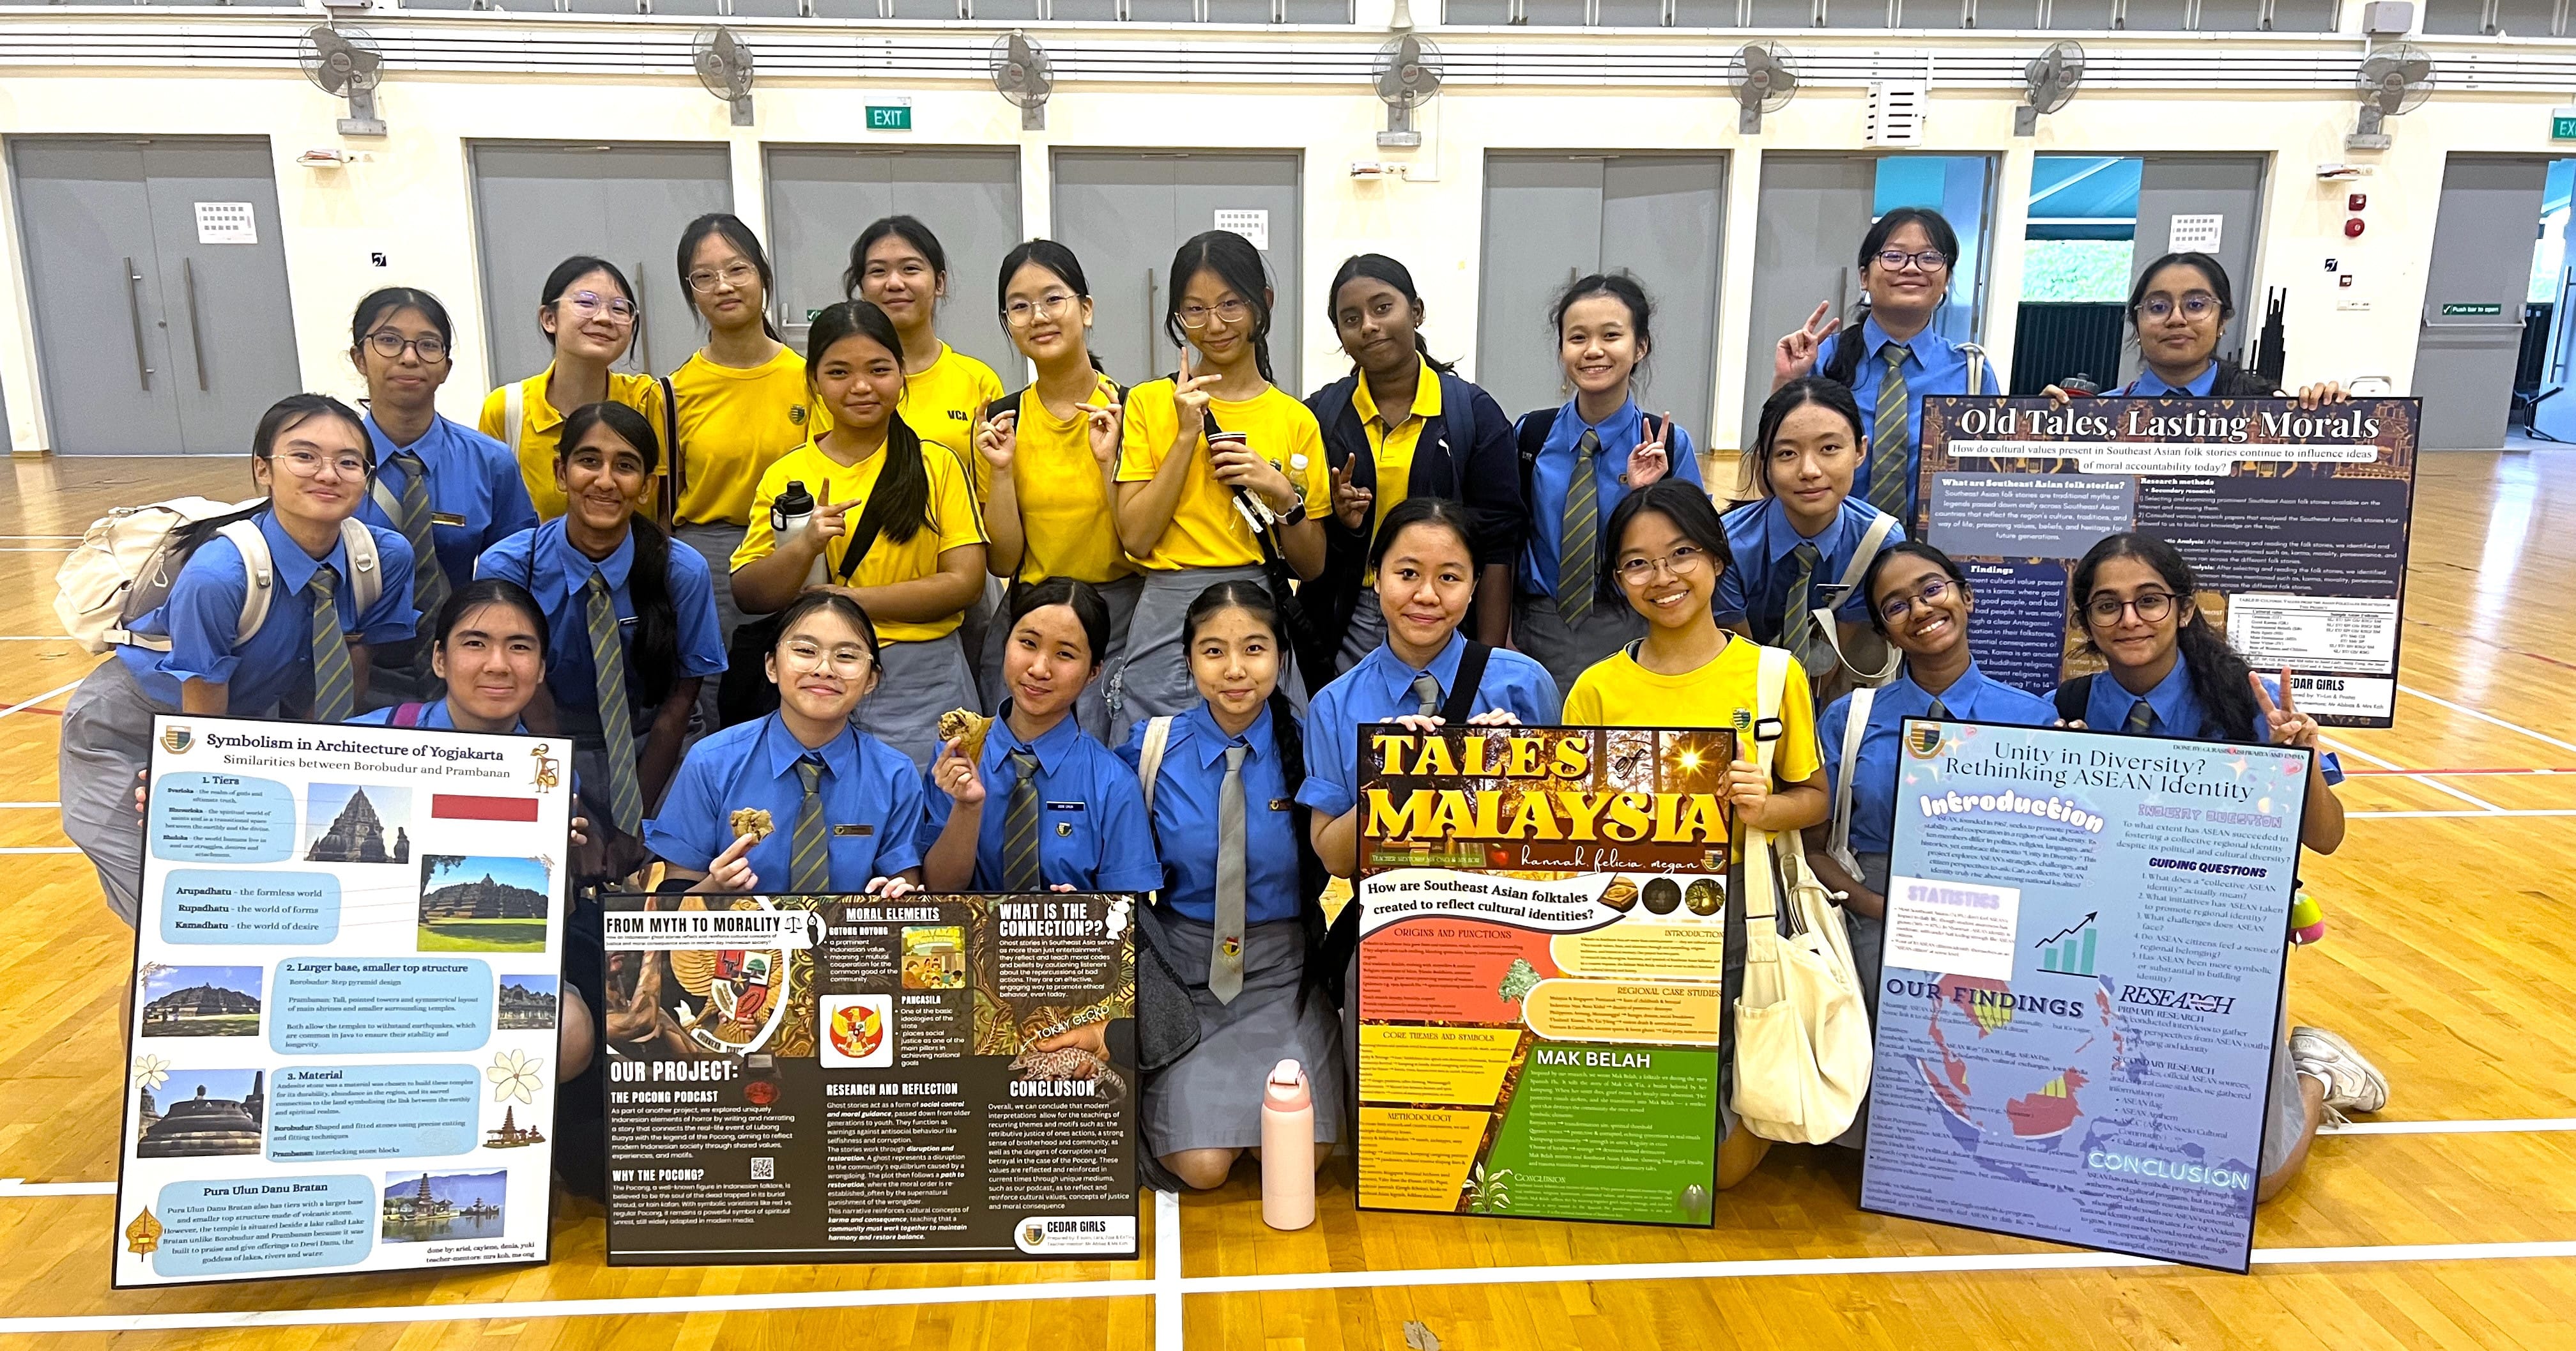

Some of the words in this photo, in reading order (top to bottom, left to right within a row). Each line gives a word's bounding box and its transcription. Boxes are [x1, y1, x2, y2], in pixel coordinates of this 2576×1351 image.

[874, 110, 902, 125] EXIT
[947, 410, 968, 421] VCA
[1961, 408, 2016, 435] Old
[2025, 408, 2117, 438] Tales,
[2128, 410, 2251, 443] Lasting
[2259, 410, 2380, 439] Morals
[1953, 445, 1974, 453] How
[1991, 445, 2025, 453] cultural
[2058, 447, 2092, 456] present
[2095, 446, 2104, 454] in
[2107, 446, 2151, 455] Southeast
[2154, 447, 2181, 456] Asian
[2184, 447, 2203, 456] folk
[2240, 449, 2281, 457] continue
[2297, 448, 2343, 458] influence
[2347, 449, 2372, 458] ideas
[2084, 461, 2094, 470] of
[2096, 461, 2122, 470] moral
[2125, 460, 2191, 472] accountability
[2195, 463, 2226, 472] today?
[1942, 479, 1967, 487] What
[2086, 481, 2125, 489] stories?
[1971, 566, 2013, 575] Findings
[2317, 679, 2344, 691] GIRLS
[207, 734, 292, 749] Symbolism
[298, 738, 311, 750] in
[316, 740, 408, 755] Architecture
[413, 745, 428, 757] of
[430, 746, 503, 760] Yogjakarta
[1374, 734, 1590, 778] TALES
[1995, 742, 2053, 765] Unity
[2062, 749, 2081, 764] in
[2091, 750, 2205, 776] Diversity?
[224, 755, 295, 767] Similarities
[299, 759, 350, 769] between
[355, 762, 418, 773] Borobudur
[421, 766, 441, 775] and
[446, 766, 510, 778] Prambanan
[213, 776, 240, 785] Tiers
[1947, 758, 2067, 789] Rethinking
[2073, 769, 2152, 792] ASEAN
[2161, 776, 2253, 803] Identity
[1364, 790, 1728, 844] MALAYSIA
[1920, 789, 2104, 834] Introduction
[1652, 861, 1700, 880] megan
[2149, 858, 2196, 871] GUIDING
[2199, 863, 2267, 877] QUESTIONS
[176, 887, 231, 895] Arupadhatu
[1368, 881, 1395, 894] How
[1399, 883, 1420, 891] are
[1424, 880, 1488, 894] Southeast
[1491, 885, 1528, 899] Asian
[1532, 890, 1588, 903] folktales
[1907, 886, 2000, 910] STATISTICS
[179, 904, 229, 913] Rupadhatu
[847, 908, 882, 920] MORAL
[887, 907, 939, 920] ELEMENTS
[999, 904, 1038, 919] WHAT
[1044, 904, 1057, 919] IS
[1062, 904, 1087, 919] THE
[1374, 900, 1416, 914] created
[1420, 899, 1433, 909] to
[1436, 899, 1474, 909] reflect
[1478, 900, 1525, 916] cultural
[1529, 907, 1594, 921] identities?
[607, 918, 644, 932] FROM
[650, 918, 686, 932] MYTH
[693, 917, 709, 932] TO
[714, 916, 781, 932] MORALITY
[1000, 920, 1102, 936] CONNECTION??
[1459, 930, 1512, 938] FUNCTIONS
[298, 964, 332, 973] Larger
[335, 964, 360, 972] base,
[363, 964, 401, 972] smaller
[403, 964, 419, 974] top
[901, 996, 940, 1004] PANCASILA
[1887, 979, 1942, 1000] OUR
[1954, 987, 2085, 1019] FINDINGS
[1036, 1019, 1070, 1040] TOKAY
[1072, 1006, 1110, 1025] GECKO
[1538, 1050, 1581, 1065] MAK
[1586, 1052, 1650, 1068] BELAH
[299, 1071, 342, 1080] Material
[611, 1062, 646, 1082] OUR
[653, 1061, 738, 1081] PROJECT:
[827, 1084, 875, 1095] RESEARCH
[879, 1084, 898, 1095] AND
[902, 1083, 958, 1094] REFLECTION
[1010, 1081, 1094, 1096] CONCLUSION
[611, 1092, 629, 1103] THE
[632, 1092, 671, 1103] POCONG
[675, 1091, 718, 1102] PODCAST
[1388, 1113, 1451, 1122] METHODOLOGY
[613, 1170, 634, 1181] WHY
[638, 1170, 656, 1181] THE
[659, 1169, 703, 1180] POCONG?
[2088, 1151, 2250, 1190] CONCLUSION
[204, 1188, 229, 1196] Pura
[233, 1185, 258, 1194] Ulun
[262, 1185, 289, 1194] Danu
[293, 1184, 328, 1193] Bratan
[1048, 1222, 1077, 1232] CEDAR
[1080, 1221, 1106, 1231] GIRLS
